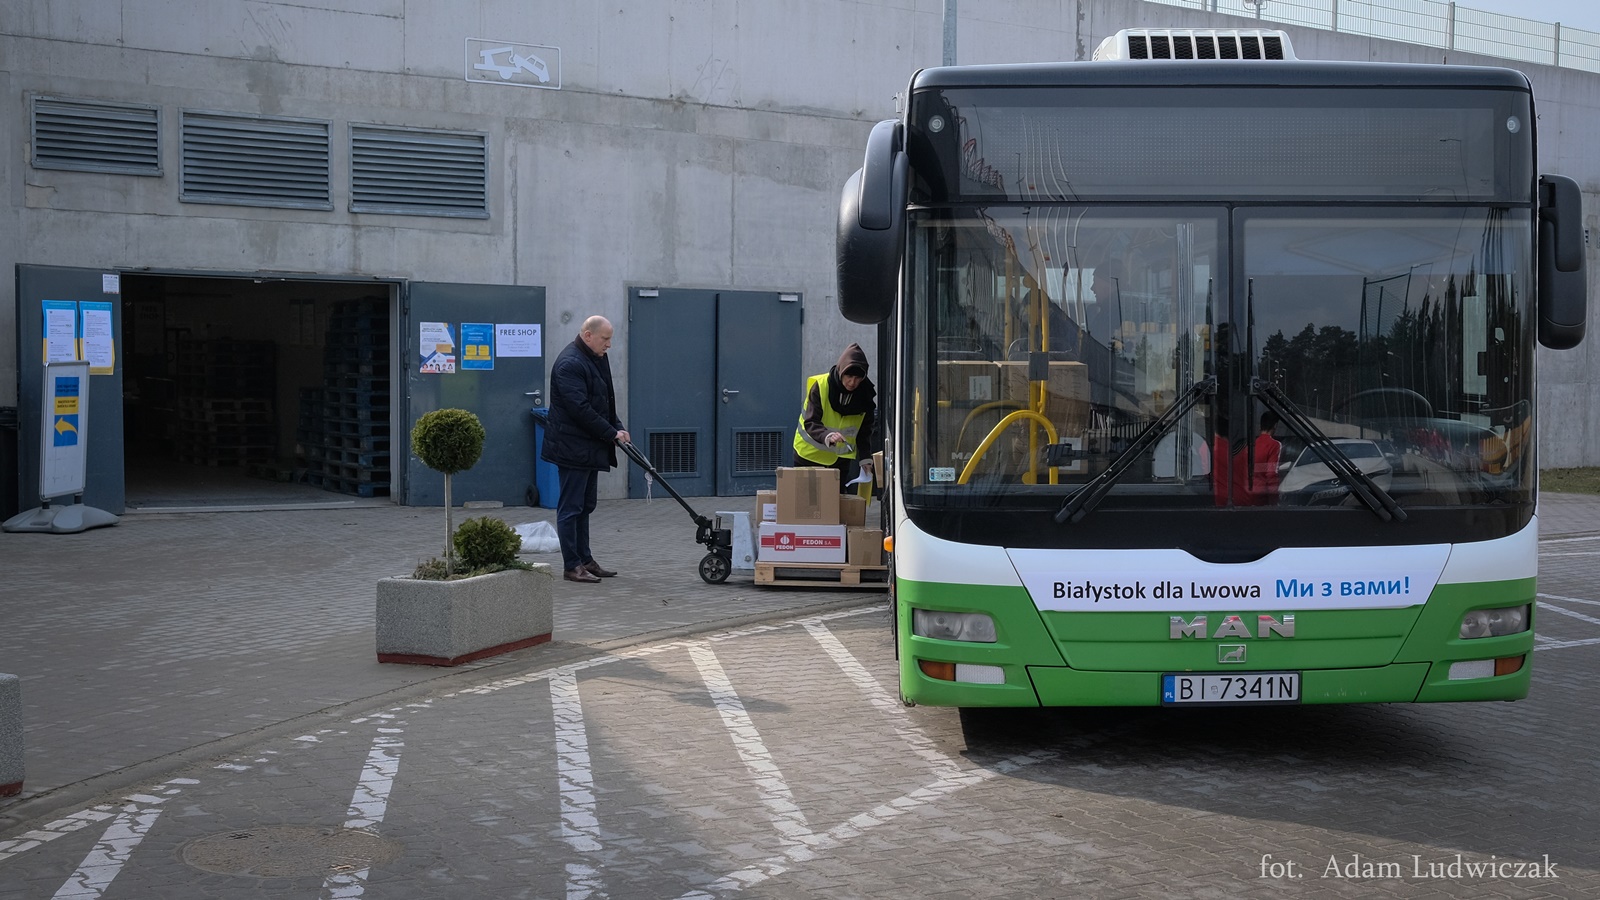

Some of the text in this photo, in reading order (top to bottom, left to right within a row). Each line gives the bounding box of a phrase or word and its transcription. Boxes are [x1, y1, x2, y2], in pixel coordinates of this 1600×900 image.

[1053, 581, 1261, 602] Białystok dla Lwowa
[1276, 576, 1410, 597] Ми з вами!
[1169, 614, 1295, 639] MAN
